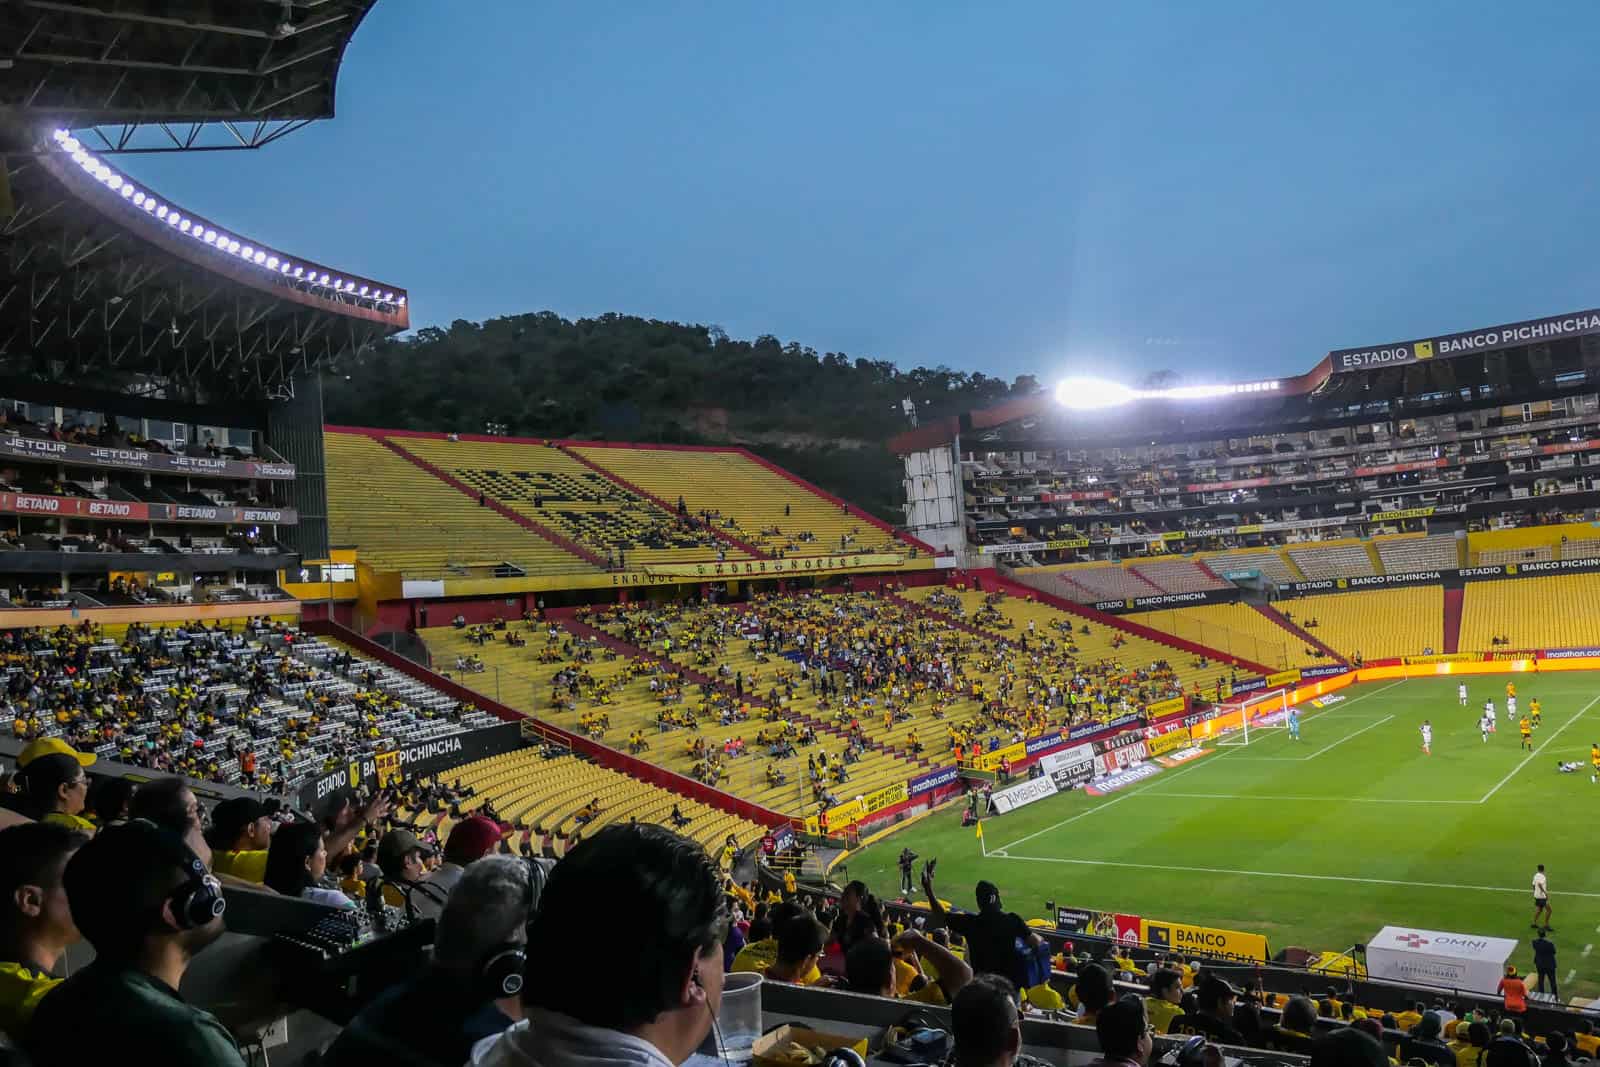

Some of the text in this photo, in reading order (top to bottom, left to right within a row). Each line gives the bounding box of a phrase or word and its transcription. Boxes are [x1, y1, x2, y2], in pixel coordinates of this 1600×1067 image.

[1342, 313, 1600, 367] ESTADIO BANCO PICHINCHA
[5, 438, 67, 453] JETOUR
[90, 448, 149, 461] JETOUR
[170, 457, 226, 468] JETOUR
[16, 497, 58, 511] BETANO
[89, 503, 130, 515] BETANO
[178, 507, 216, 518] BETANO
[244, 511, 281, 521] BETANO
[1459, 567, 1502, 577] ESTADIO
[1522, 561, 1560, 572] BANCO
[1296, 571, 1441, 591] ESTADIO BANCO PICHINCHA
[1096, 592, 1207, 610] ESTADIO BANCO PICHINCHA
[400, 738, 462, 766] PICHINCHA
[1114, 741, 1147, 769] BETANO
[1054, 761, 1092, 782] JETOUR
[317, 770, 346, 799] ESTADIO
[1176, 929, 1226, 948] BANCO
[1434, 937, 1487, 949] OMNI
